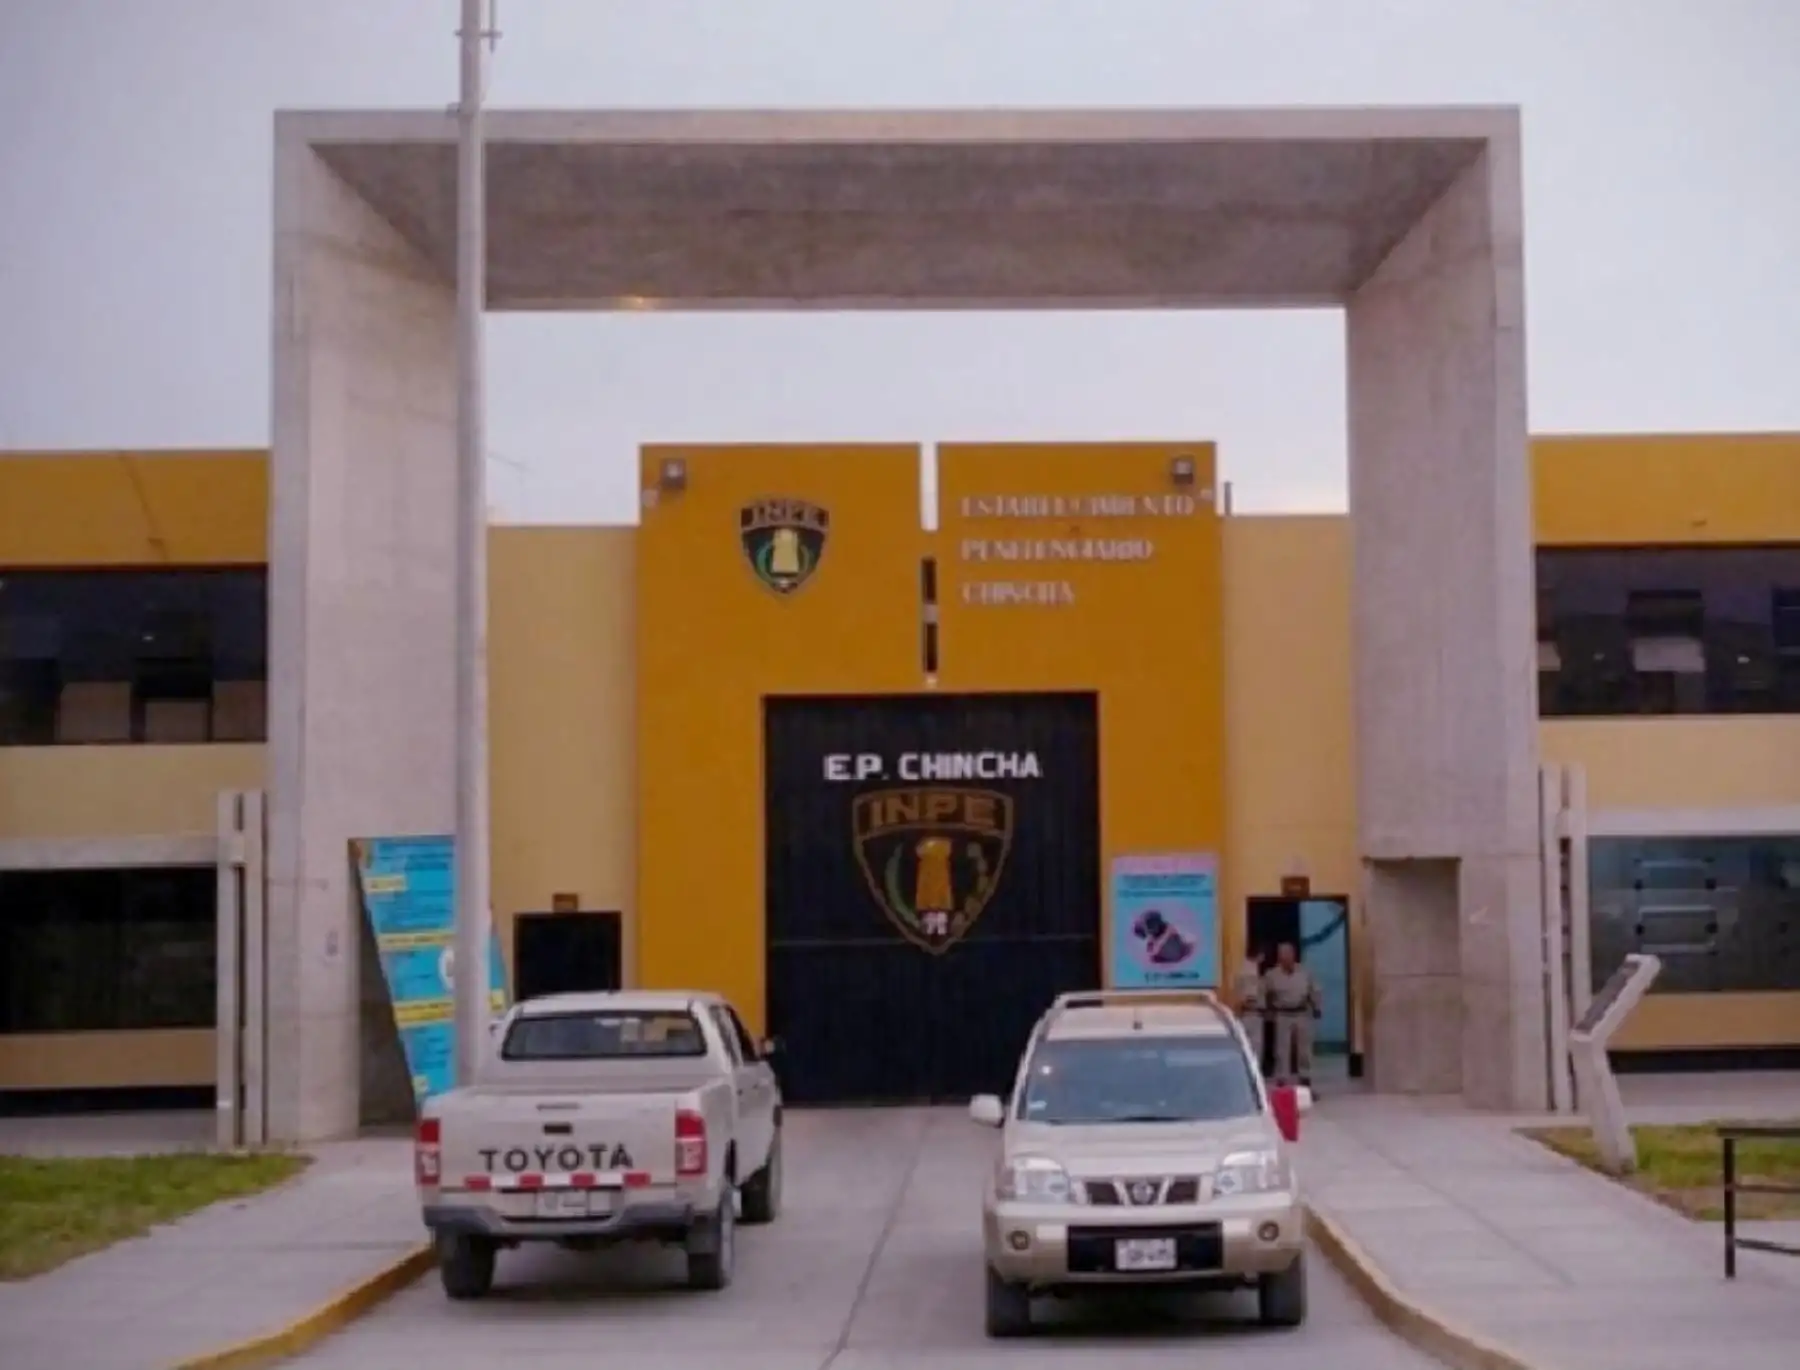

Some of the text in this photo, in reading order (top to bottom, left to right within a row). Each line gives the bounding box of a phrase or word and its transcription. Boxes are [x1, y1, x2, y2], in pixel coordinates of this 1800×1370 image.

[898, 752, 1041, 780] CHINCHA
[870, 793, 998, 829] INPE
[479, 1143, 633, 1172] TOYOTA
